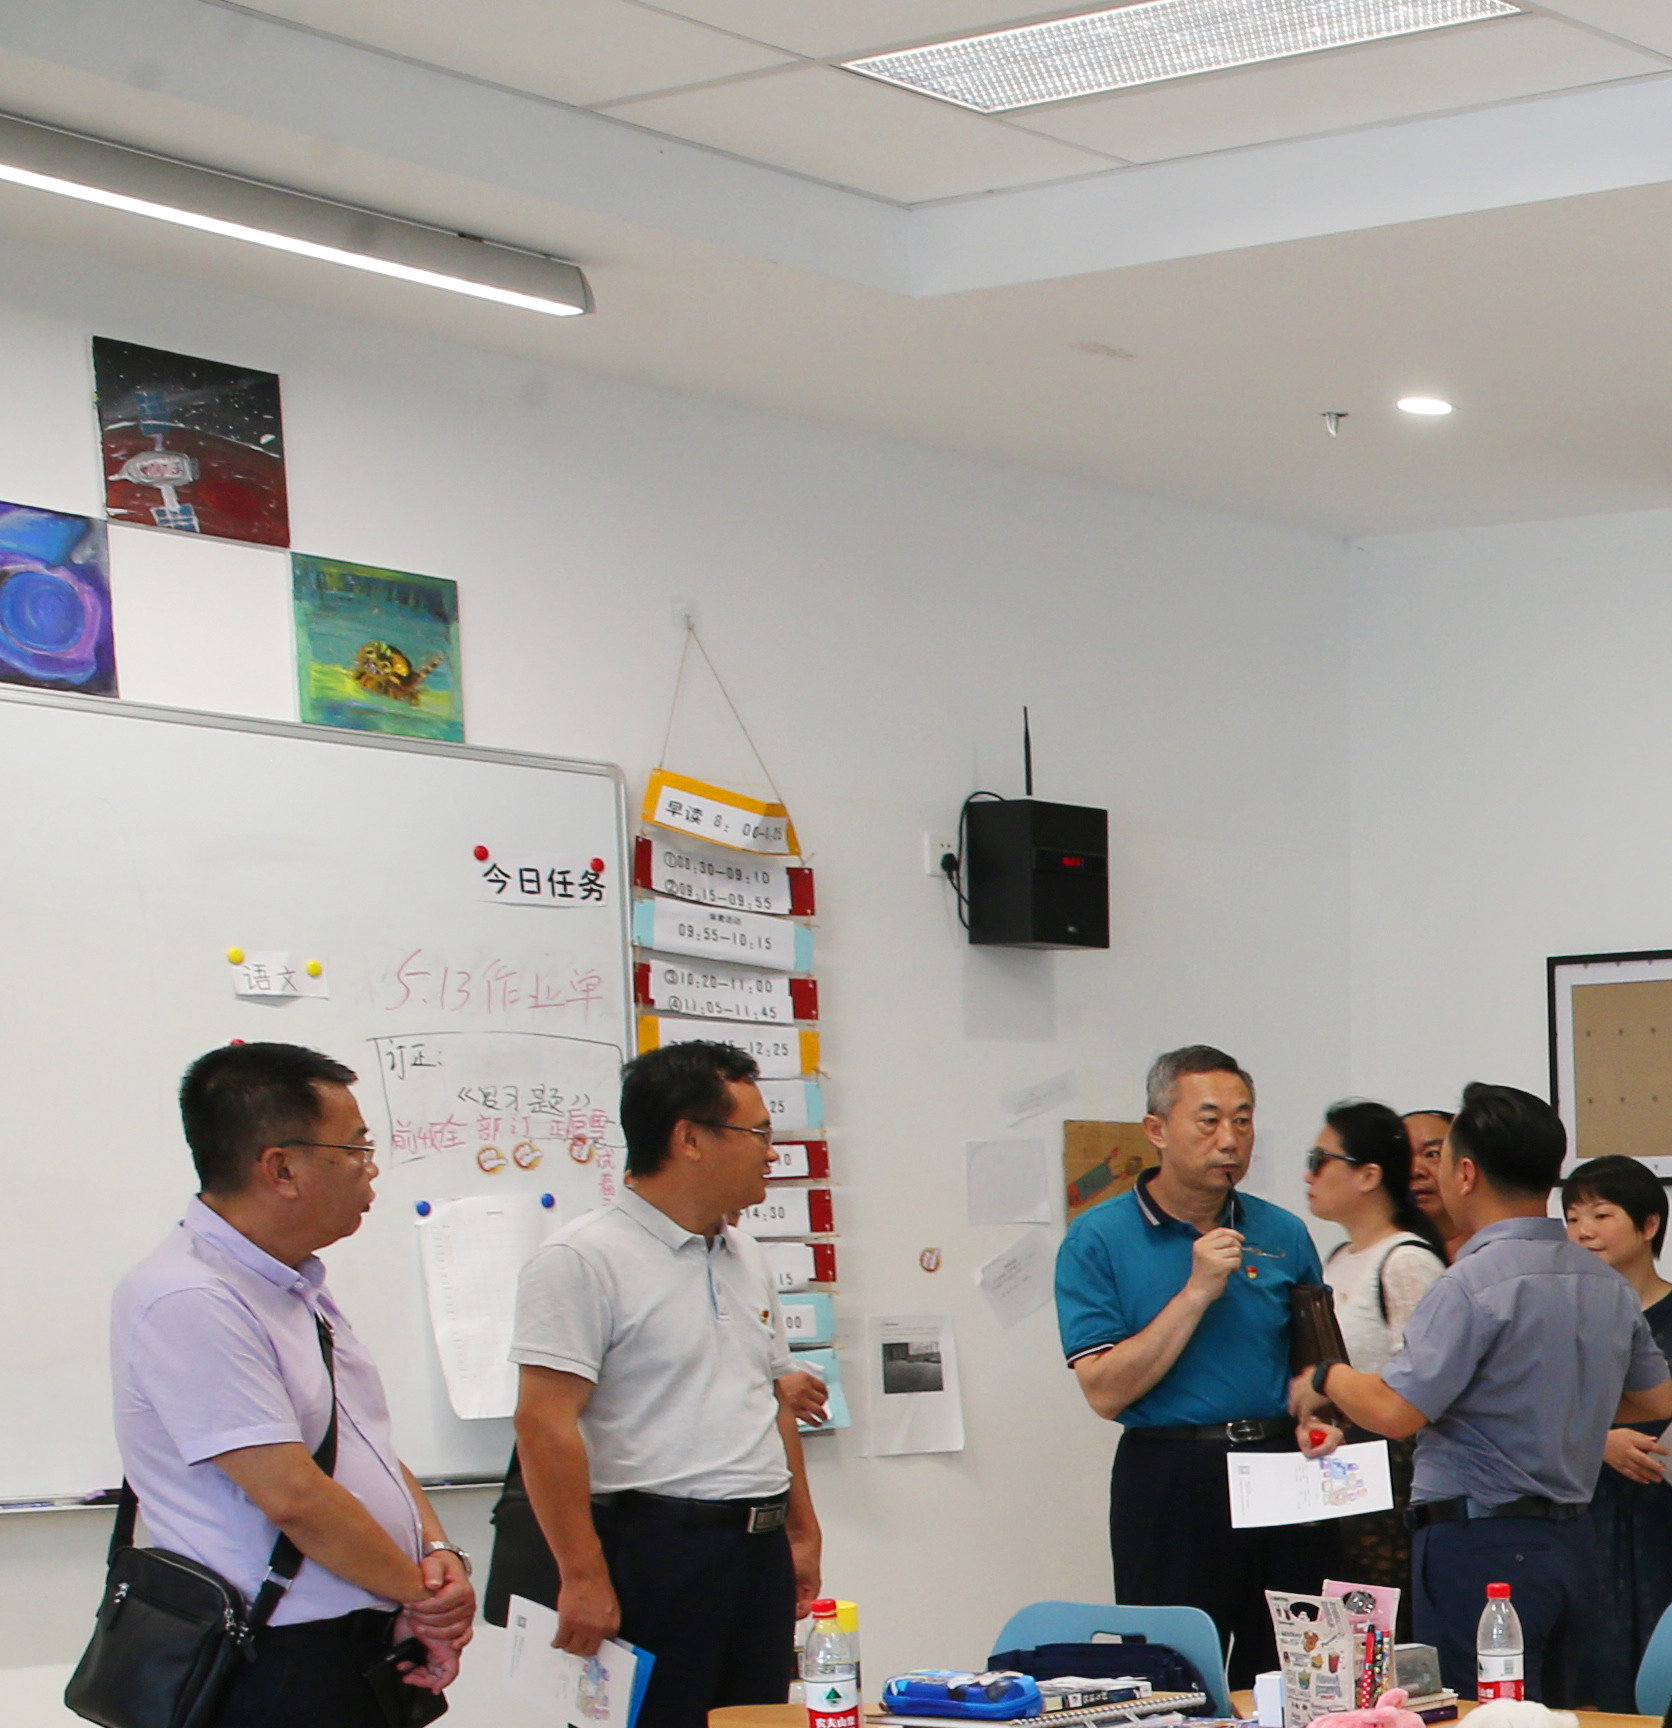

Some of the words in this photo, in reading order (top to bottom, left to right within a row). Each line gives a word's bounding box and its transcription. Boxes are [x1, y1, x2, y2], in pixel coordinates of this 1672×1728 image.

[665, 800, 704, 826] 早读
[482, 863, 607, 902] 今日任务
[244, 964, 299, 992] 语文
